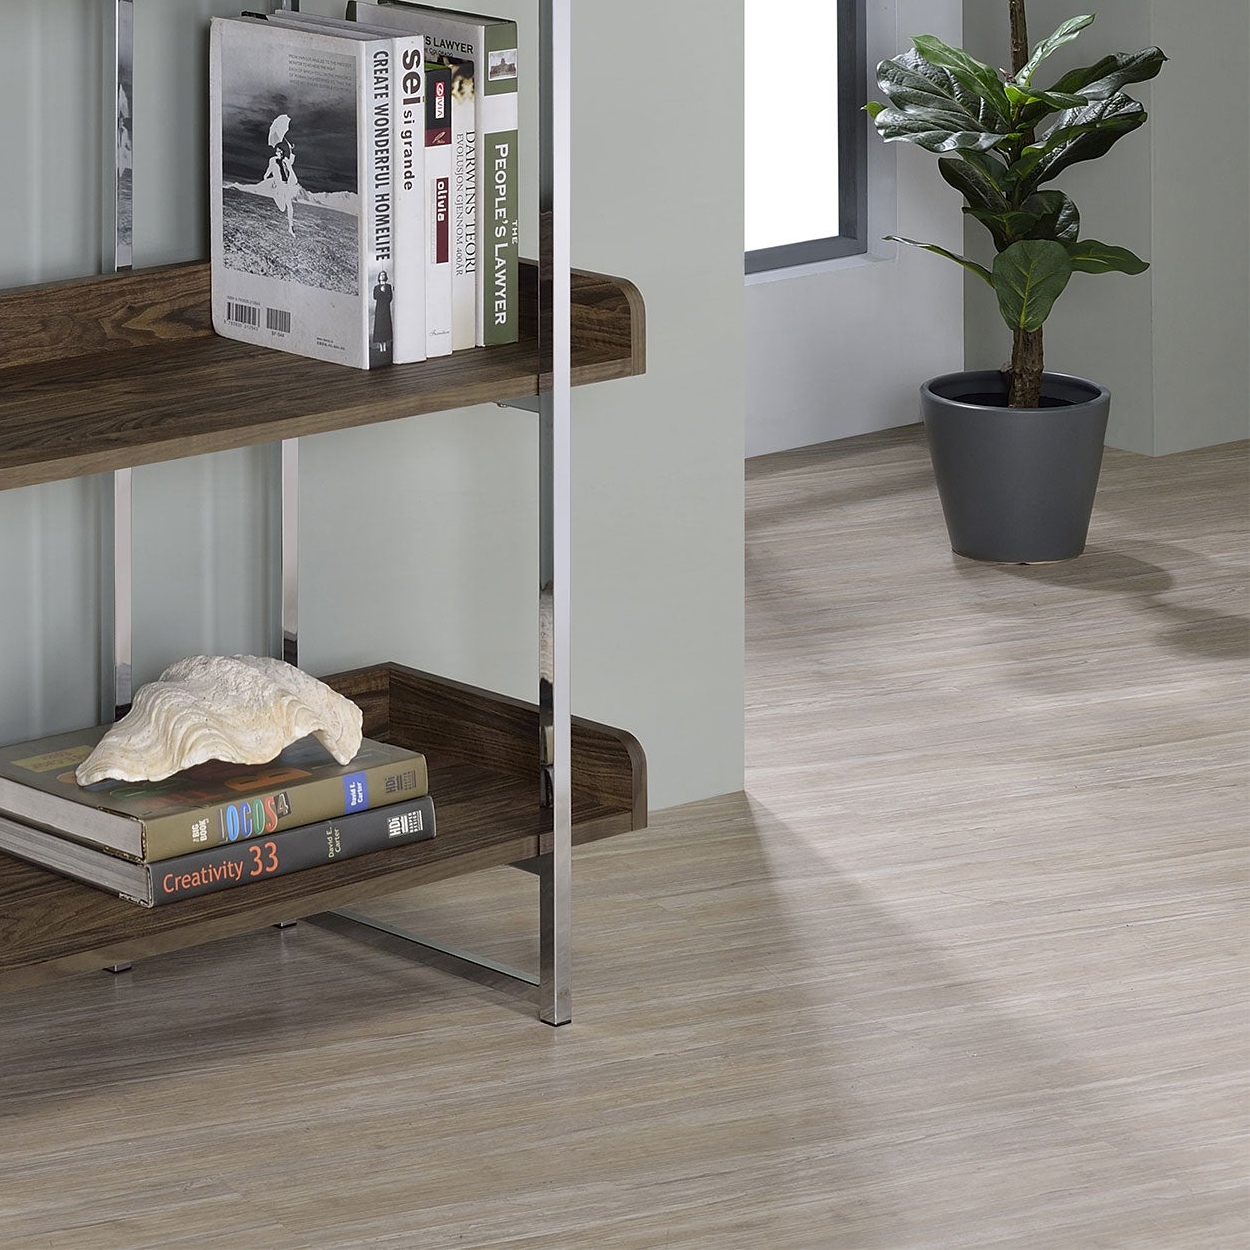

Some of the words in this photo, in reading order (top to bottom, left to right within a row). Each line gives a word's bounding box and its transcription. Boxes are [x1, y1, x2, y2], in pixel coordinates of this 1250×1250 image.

[433, 37, 474, 55] LAWYER
[373, 50, 389, 100] CREATE
[403, 110, 415, 124] si
[374, 103, 390, 189] WONDERFUL
[401, 130, 415, 191] grande
[454, 134, 464, 192] EVOLUSJON
[465, 131, 476, 215] DARWINS
[494, 143, 509, 238] PEOPLE'S
[374, 193, 391, 261] HOMELIFE
[436, 181, 448, 222] olivia
[454, 194, 464, 245] GJENNOM
[465, 219, 476, 274] TEORI
[494, 242, 509, 325] LAWYER
[191, 823, 200, 838] BIG
[327, 834, 335, 858] David
[332, 829, 341, 853] Carter
[163, 861, 244, 894] Creativity
[249, 841, 279, 877] 33
